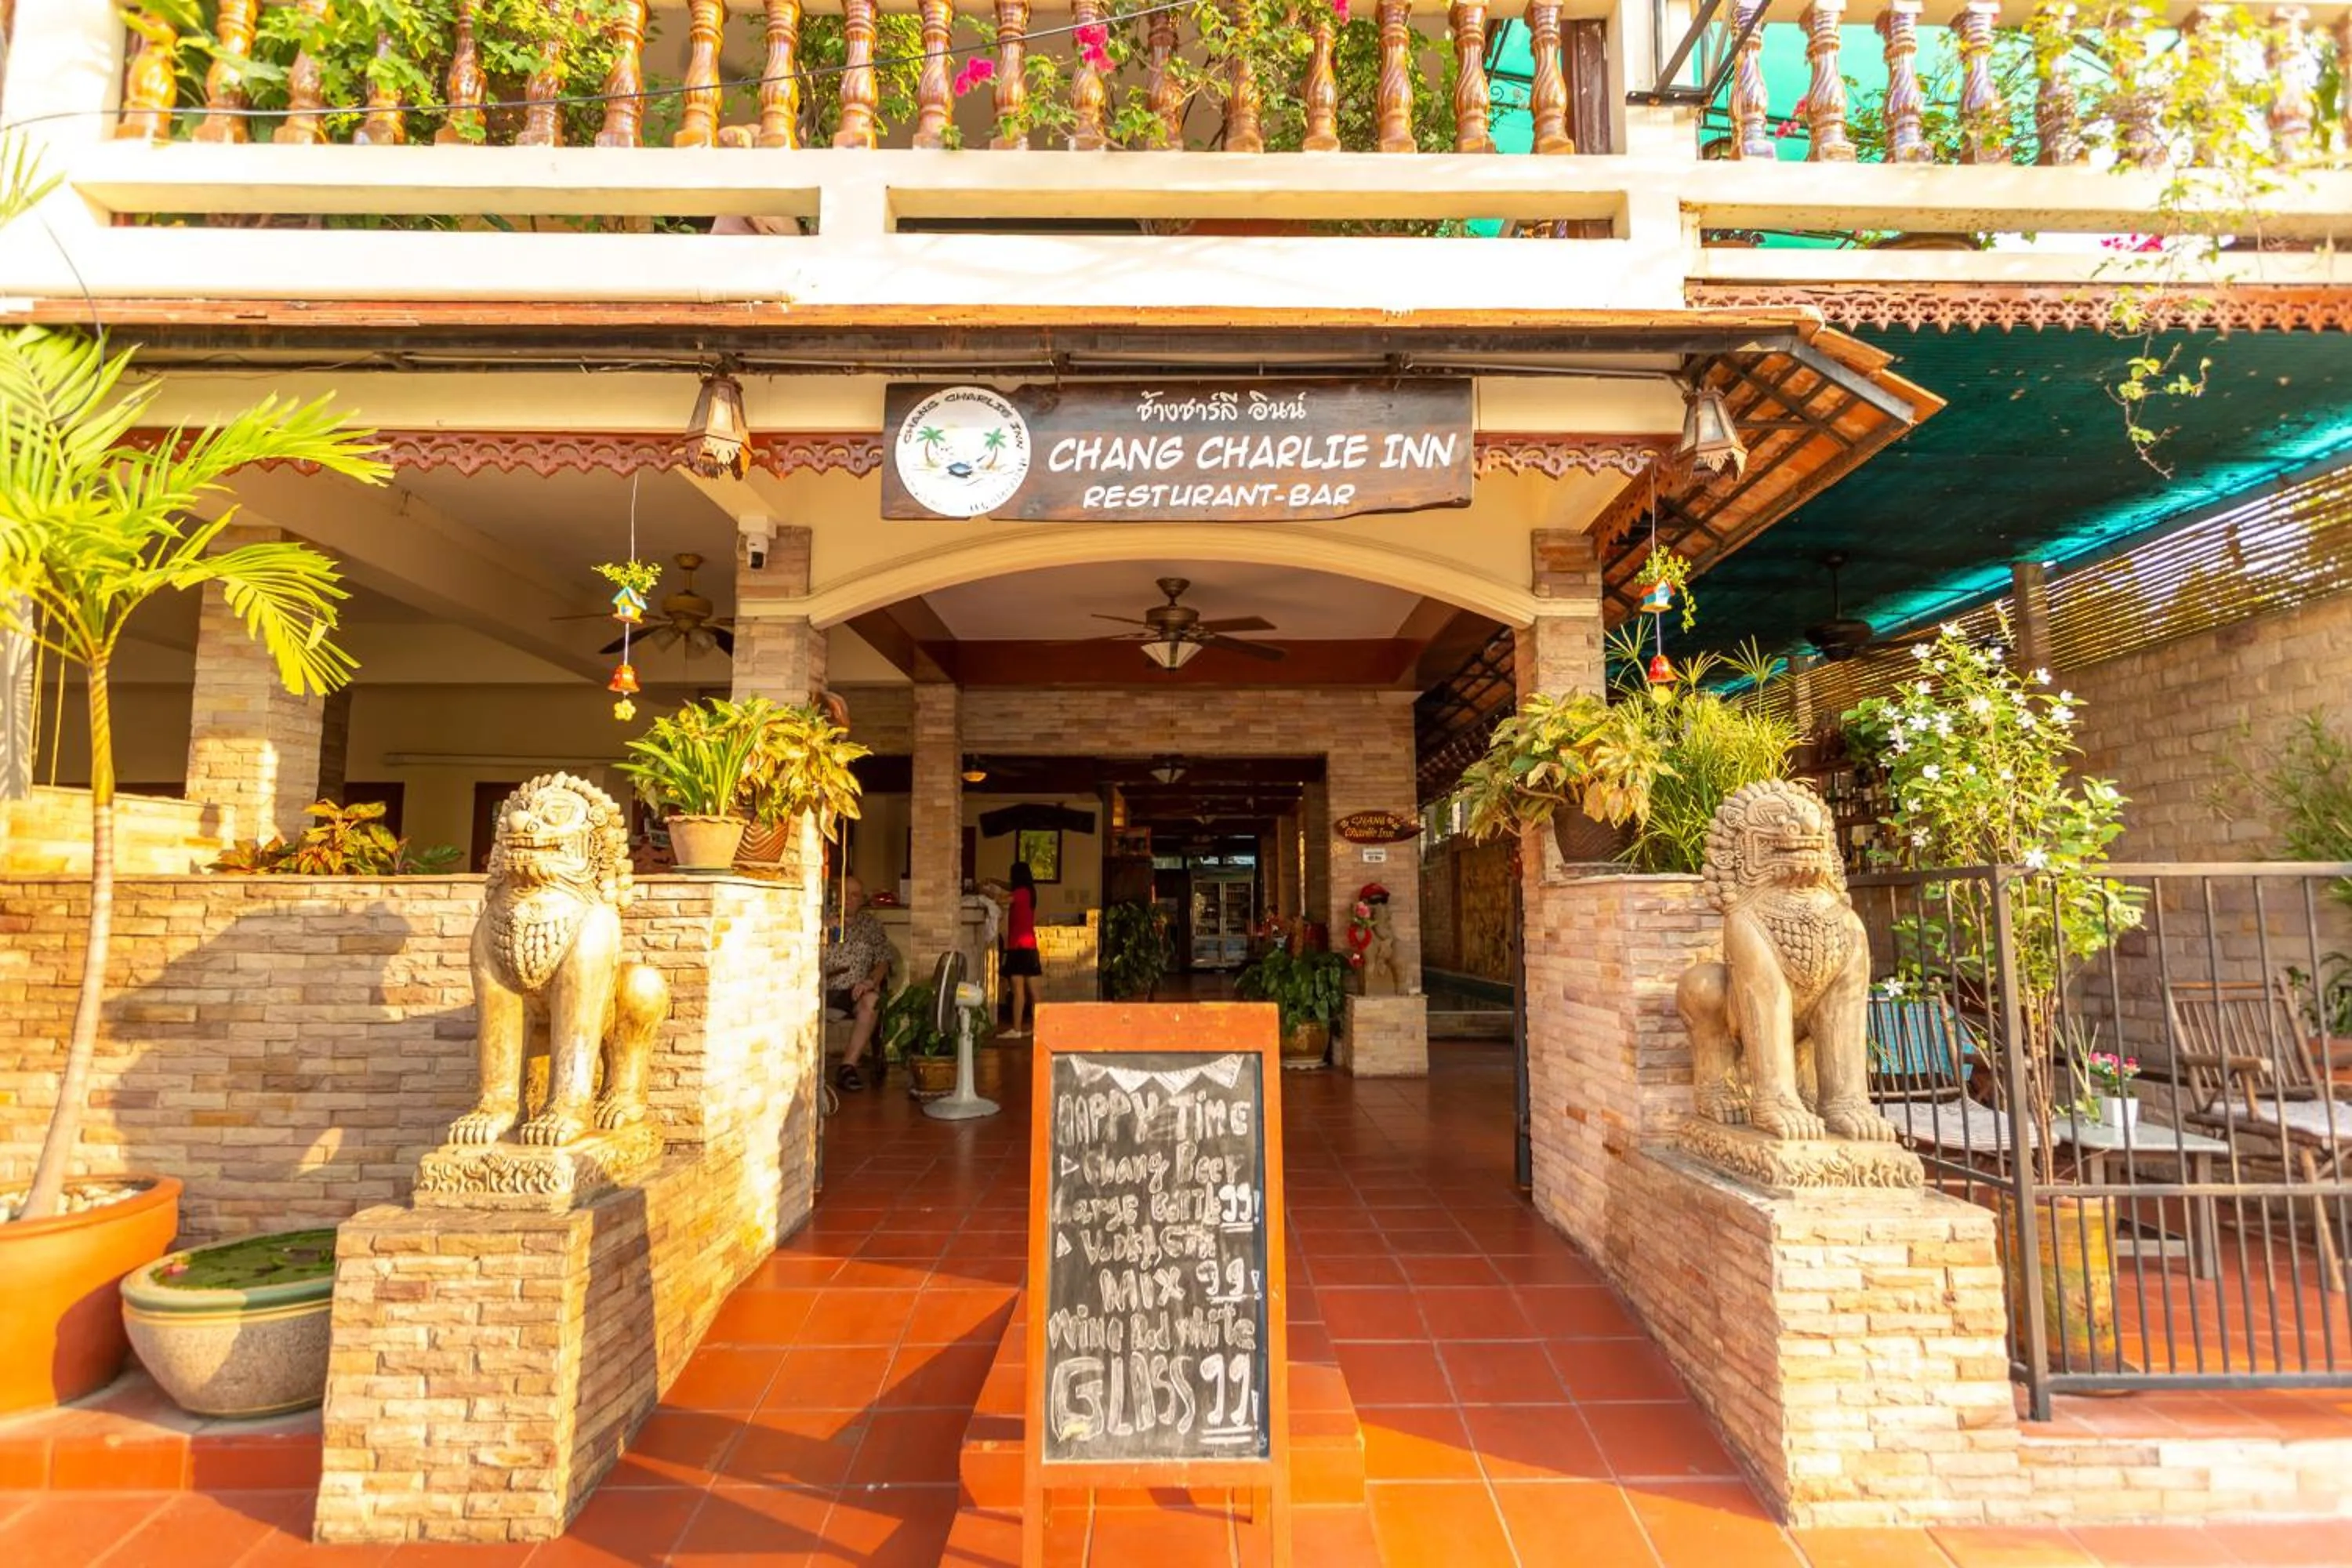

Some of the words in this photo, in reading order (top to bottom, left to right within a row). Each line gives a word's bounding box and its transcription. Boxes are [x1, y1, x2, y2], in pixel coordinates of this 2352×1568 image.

[904, 401, 940, 444] CHANG
[1048, 436, 1185, 472] CHANG
[1196, 434, 1369, 470] CHARLIE
[1379, 434, 1457, 470] INN
[1083, 484, 1356, 509] RESTURANT-BAR
[1051, 1352, 1196, 1442] GLASS
